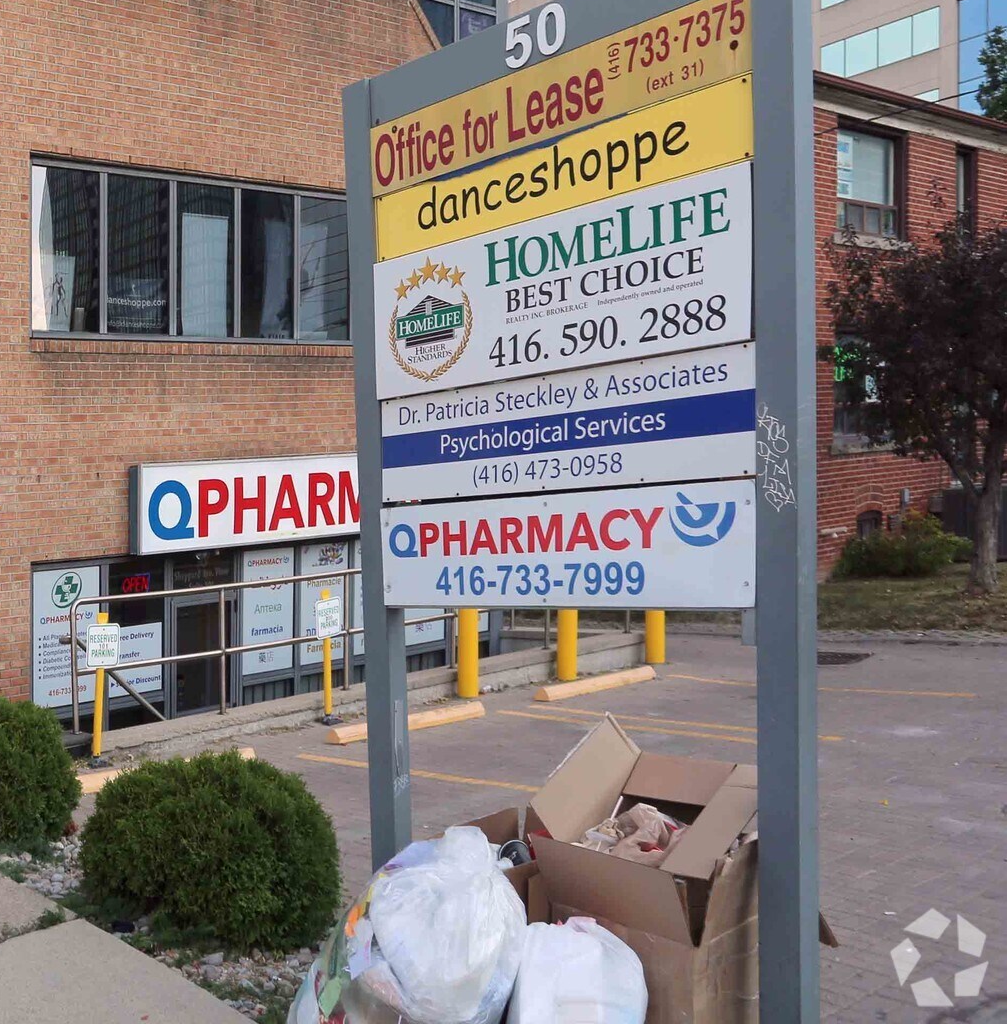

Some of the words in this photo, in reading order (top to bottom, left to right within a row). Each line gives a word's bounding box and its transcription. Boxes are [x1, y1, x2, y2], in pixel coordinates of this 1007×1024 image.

[505, 3, 566, 69] 50
[646, 72, 674, 94] (ext
[681, 59, 704, 81] 31)
[375, 121, 454, 187] Office
[463, 108, 498, 158] for
[506, 68, 604, 143] Lease
[607, 42, 621, 80] (416)
[418, 121, 689, 230] danceshoppe
[484, 188, 730, 287] HOMELIFE
[505, 277, 571, 313] BEST
[580, 247, 704, 297] CHOICE
[597, 292, 639, 306] Independently
[641, 288, 661, 297] owned
[663, 284, 675, 293] and
[676, 279, 704, 291] operated
[399, 310, 461, 337] HOMELIFE
[505, 313, 531, 324] REALTY
[546, 302, 588, 317] BROKERAGE
[489, 329, 548, 368] 416.
[560, 315, 626, 356] 590.
[639, 294, 726, 343] 2888
[407, 350, 452, 364] STANDARDS
[415, 344, 446, 355] HIGHER
[399, 407, 420, 425] Dr.
[426, 396, 489, 422] Patricia
[496, 384, 577, 412] Steckley
[583, 378, 598, 399] &
[605, 363, 728, 397] Associates
[440, 418, 568, 458] Psychological
[575, 412, 665, 440] Services
[473, 461, 519, 488] (416)
[525, 452, 622, 480] 473-0958
[389, 507, 664, 557] QPHARMACY
[247, 557, 283, 567] QPHARMACY
[122, 576, 149, 593] OPEN
[436, 561, 645, 596] 416-733-7999
[40, 613, 84, 625] QPHARMCY
[251, 625, 283, 636] farmacia
[90, 634, 117, 643] RESERVED
[130, 631, 154, 641] Delivery
[91, 648, 115, 657] PARKING
[135, 675, 161, 684] Discount
